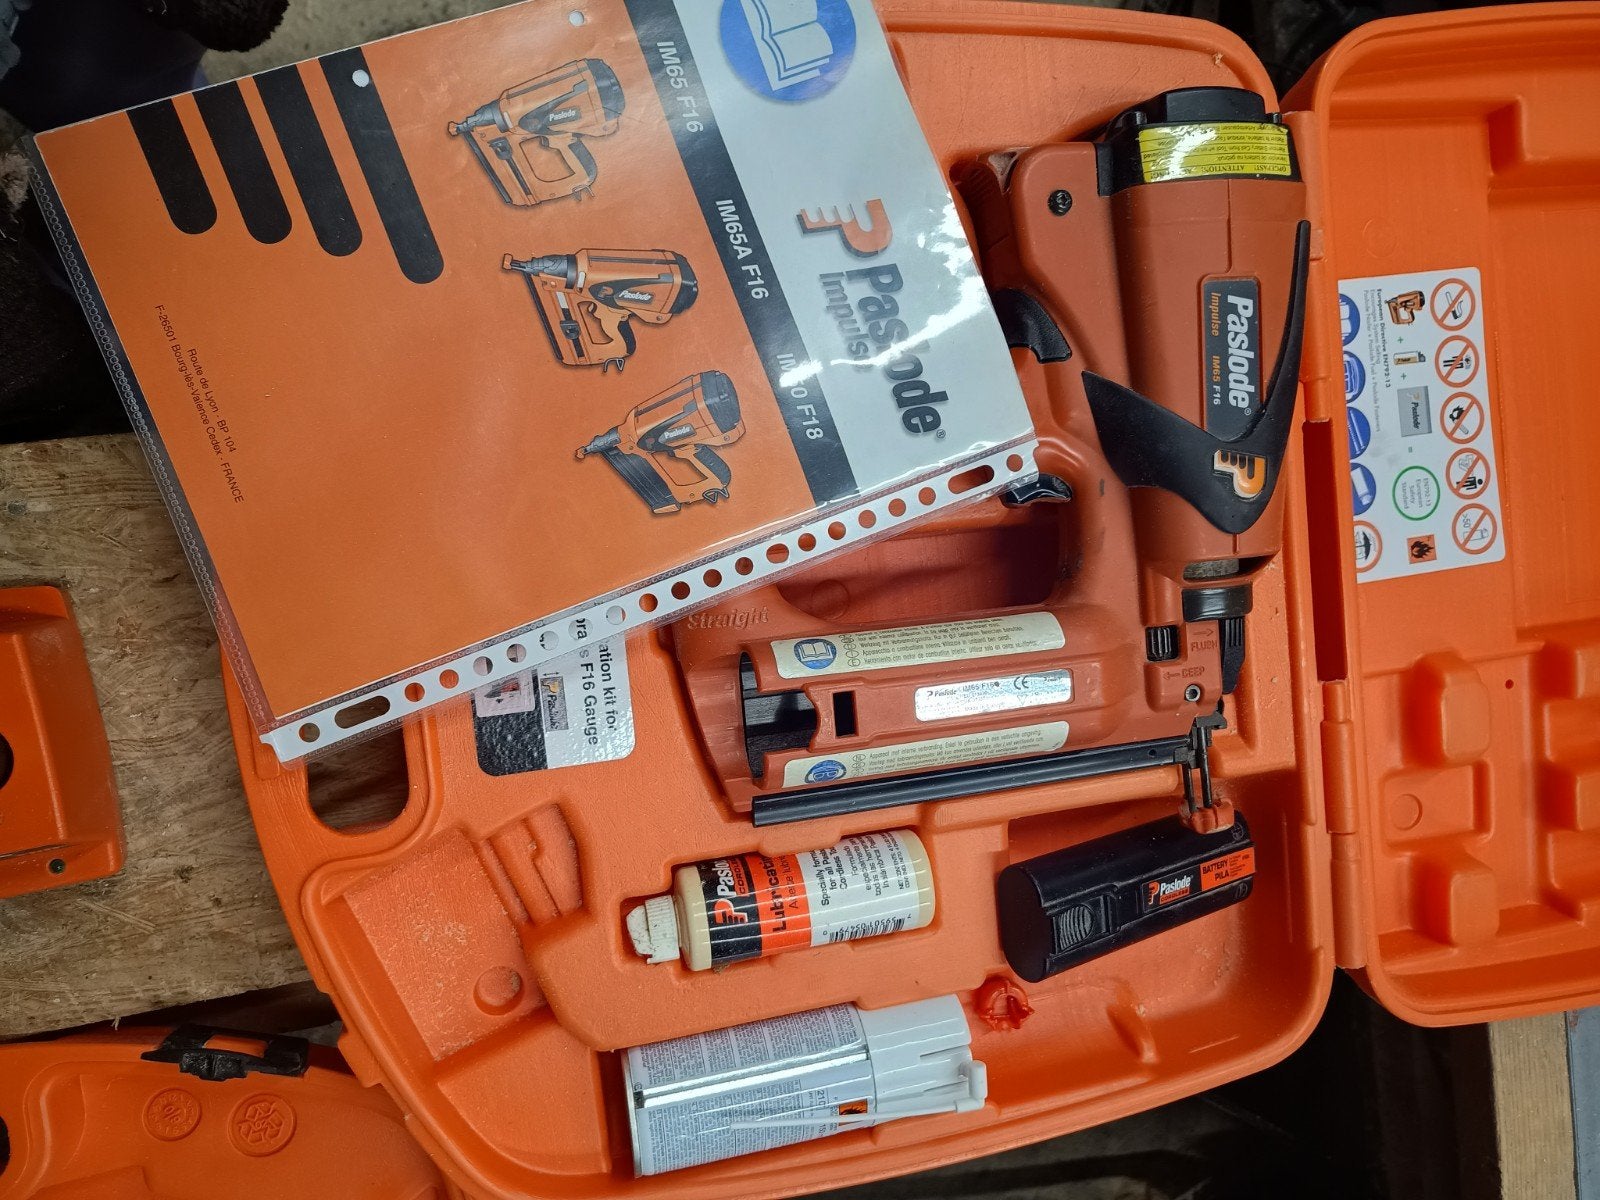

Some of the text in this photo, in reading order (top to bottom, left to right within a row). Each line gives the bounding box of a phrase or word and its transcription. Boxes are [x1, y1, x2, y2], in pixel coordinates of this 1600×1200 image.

[657, 41, 704, 133] IM65 F16
[715, 199, 770, 300] IM65A F16
[1209, 292, 1221, 405] Impulse IM65 F16
[155, 304, 177, 342] F-26501
[206, 427, 223, 456] Cedex
[221, 462, 245, 503] FRANCE
[188, 348, 237, 453] Route de Lyon BP 104
[776, 353, 824, 441] IM0 F18
[687, 606, 769, 630] Straight
[580, 661, 596, 691] F16
[598, 640, 618, 732] ation kit for
[583, 695, 599, 746] Gauge
[825, 866, 834, 875] all
[829, 877, 837, 890] for
[1159, 875, 1191, 895] Paslode
[1202, 858, 1229, 874] BATTERY
[1214, 869, 1230, 881] PILA
